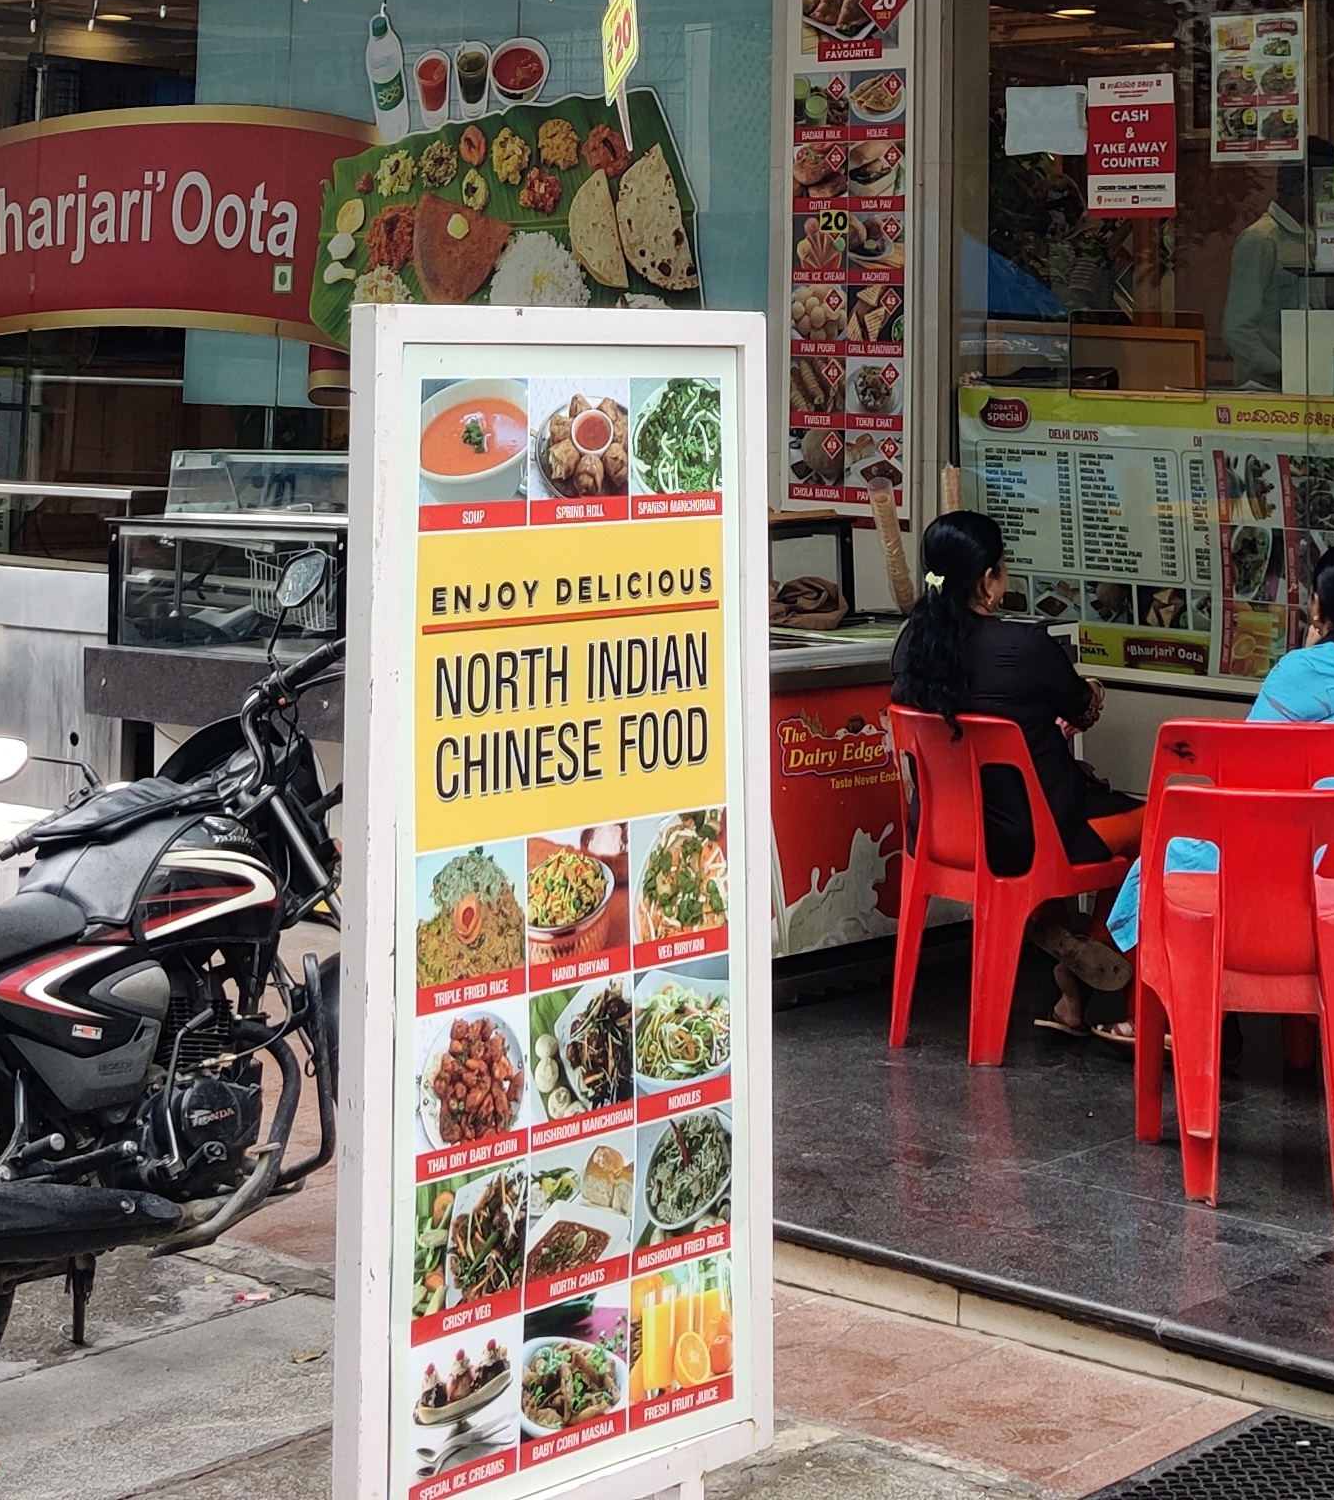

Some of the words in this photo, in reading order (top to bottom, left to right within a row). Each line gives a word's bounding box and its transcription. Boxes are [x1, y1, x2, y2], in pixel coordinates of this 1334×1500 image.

[825, 48, 876, 60] FAVOURITE
[831, 41, 867, 50] ALWAYS
[830, 82, 843, 93] 20
[1111, 109, 1150, 123] CASH
[825, 128, 842, 139] MILK
[1125, 126, 1136, 139] &
[1093, 143, 1126, 155] TAKE
[1128, 141, 1169, 154] AWAY
[830, 153, 842, 163] 20
[1101, 157, 1160, 169] COUNTER
[809, 200, 832, 210] CUTLET
[172, 171, 299, 260] Oota
[819, 211, 849, 231] 20
[822, 271, 846, 282] CREAM
[803, 414, 831, 425] TWISTER
[875, 416, 893, 428] CHAT
[986, 410, 1024, 424] special
[1048, 428, 1071, 441] DELHI
[1072, 430, 1100, 442] CHATS
[555, 504, 585, 520] SPRING
[586, 503, 605, 518] ROLL
[637, 500, 669, 515] SPANISH
[462, 510, 485, 525] SOUP
[431, 579, 539, 615] ENJOY
[557, 566, 714, 605] DELICIOUS
[1177, 647, 1204, 664] Oota
[435, 644, 570, 721] NORTH
[587, 630, 709, 702] INDIAN
[782, 726, 807, 745] The
[434, 717, 604, 803] CHINESE
[618, 706, 709, 775] FOOD
[788, 747, 838, 769] Dairy
[842, 740, 885, 764] Edge
[830, 776, 853, 790] Taste
[854, 773, 878, 788] Never
[657, 943, 673, 959] VEG
[551, 965, 577, 983] HANDI
[578, 956, 610, 979] BIRYANI
[433, 989, 463, 1008] TRIPLE
[463, 982, 489, 1002] FRIED
[489, 977, 510, 995] RICE
[667, 1088, 702, 1111] NOODLES
[191, 1107, 236, 1128] HONDA
[531, 1119, 580, 1147] MUSHROOM
[581, 1106, 634, 1136] MANCHORIAN
[427, 1154, 448, 1175] THAI
[448, 1149, 468, 1169] DRY
[468, 1143, 493, 1165] BABY
[493, 1137, 519, 1158] CORN
[636, 1244, 683, 1269] MUSHROOM
[683, 1236, 706, 1257] FRIED
[706, 1230, 725, 1249] RICE
[549, 1275, 578, 1298] NORTH
[578, 1268, 606, 1290] CHATS
[442, 1310, 474, 1332] CRISPY
[474, 1303, 492, 1322] VEG
[643, 1403, 671, 1423] FRESH
[671, 1394, 695, 1415] FRUIT
[695, 1385, 720, 1407] JUICE
[532, 1440, 557, 1462] BABY
[556, 1432, 581, 1454] CORN
[581, 1419, 615, 1444] MASALA
[419, 1478, 451, 1500] SPECIAL
[452, 1471, 469, 1491] ICE
[469, 1458, 505, 1484] CREAMS
